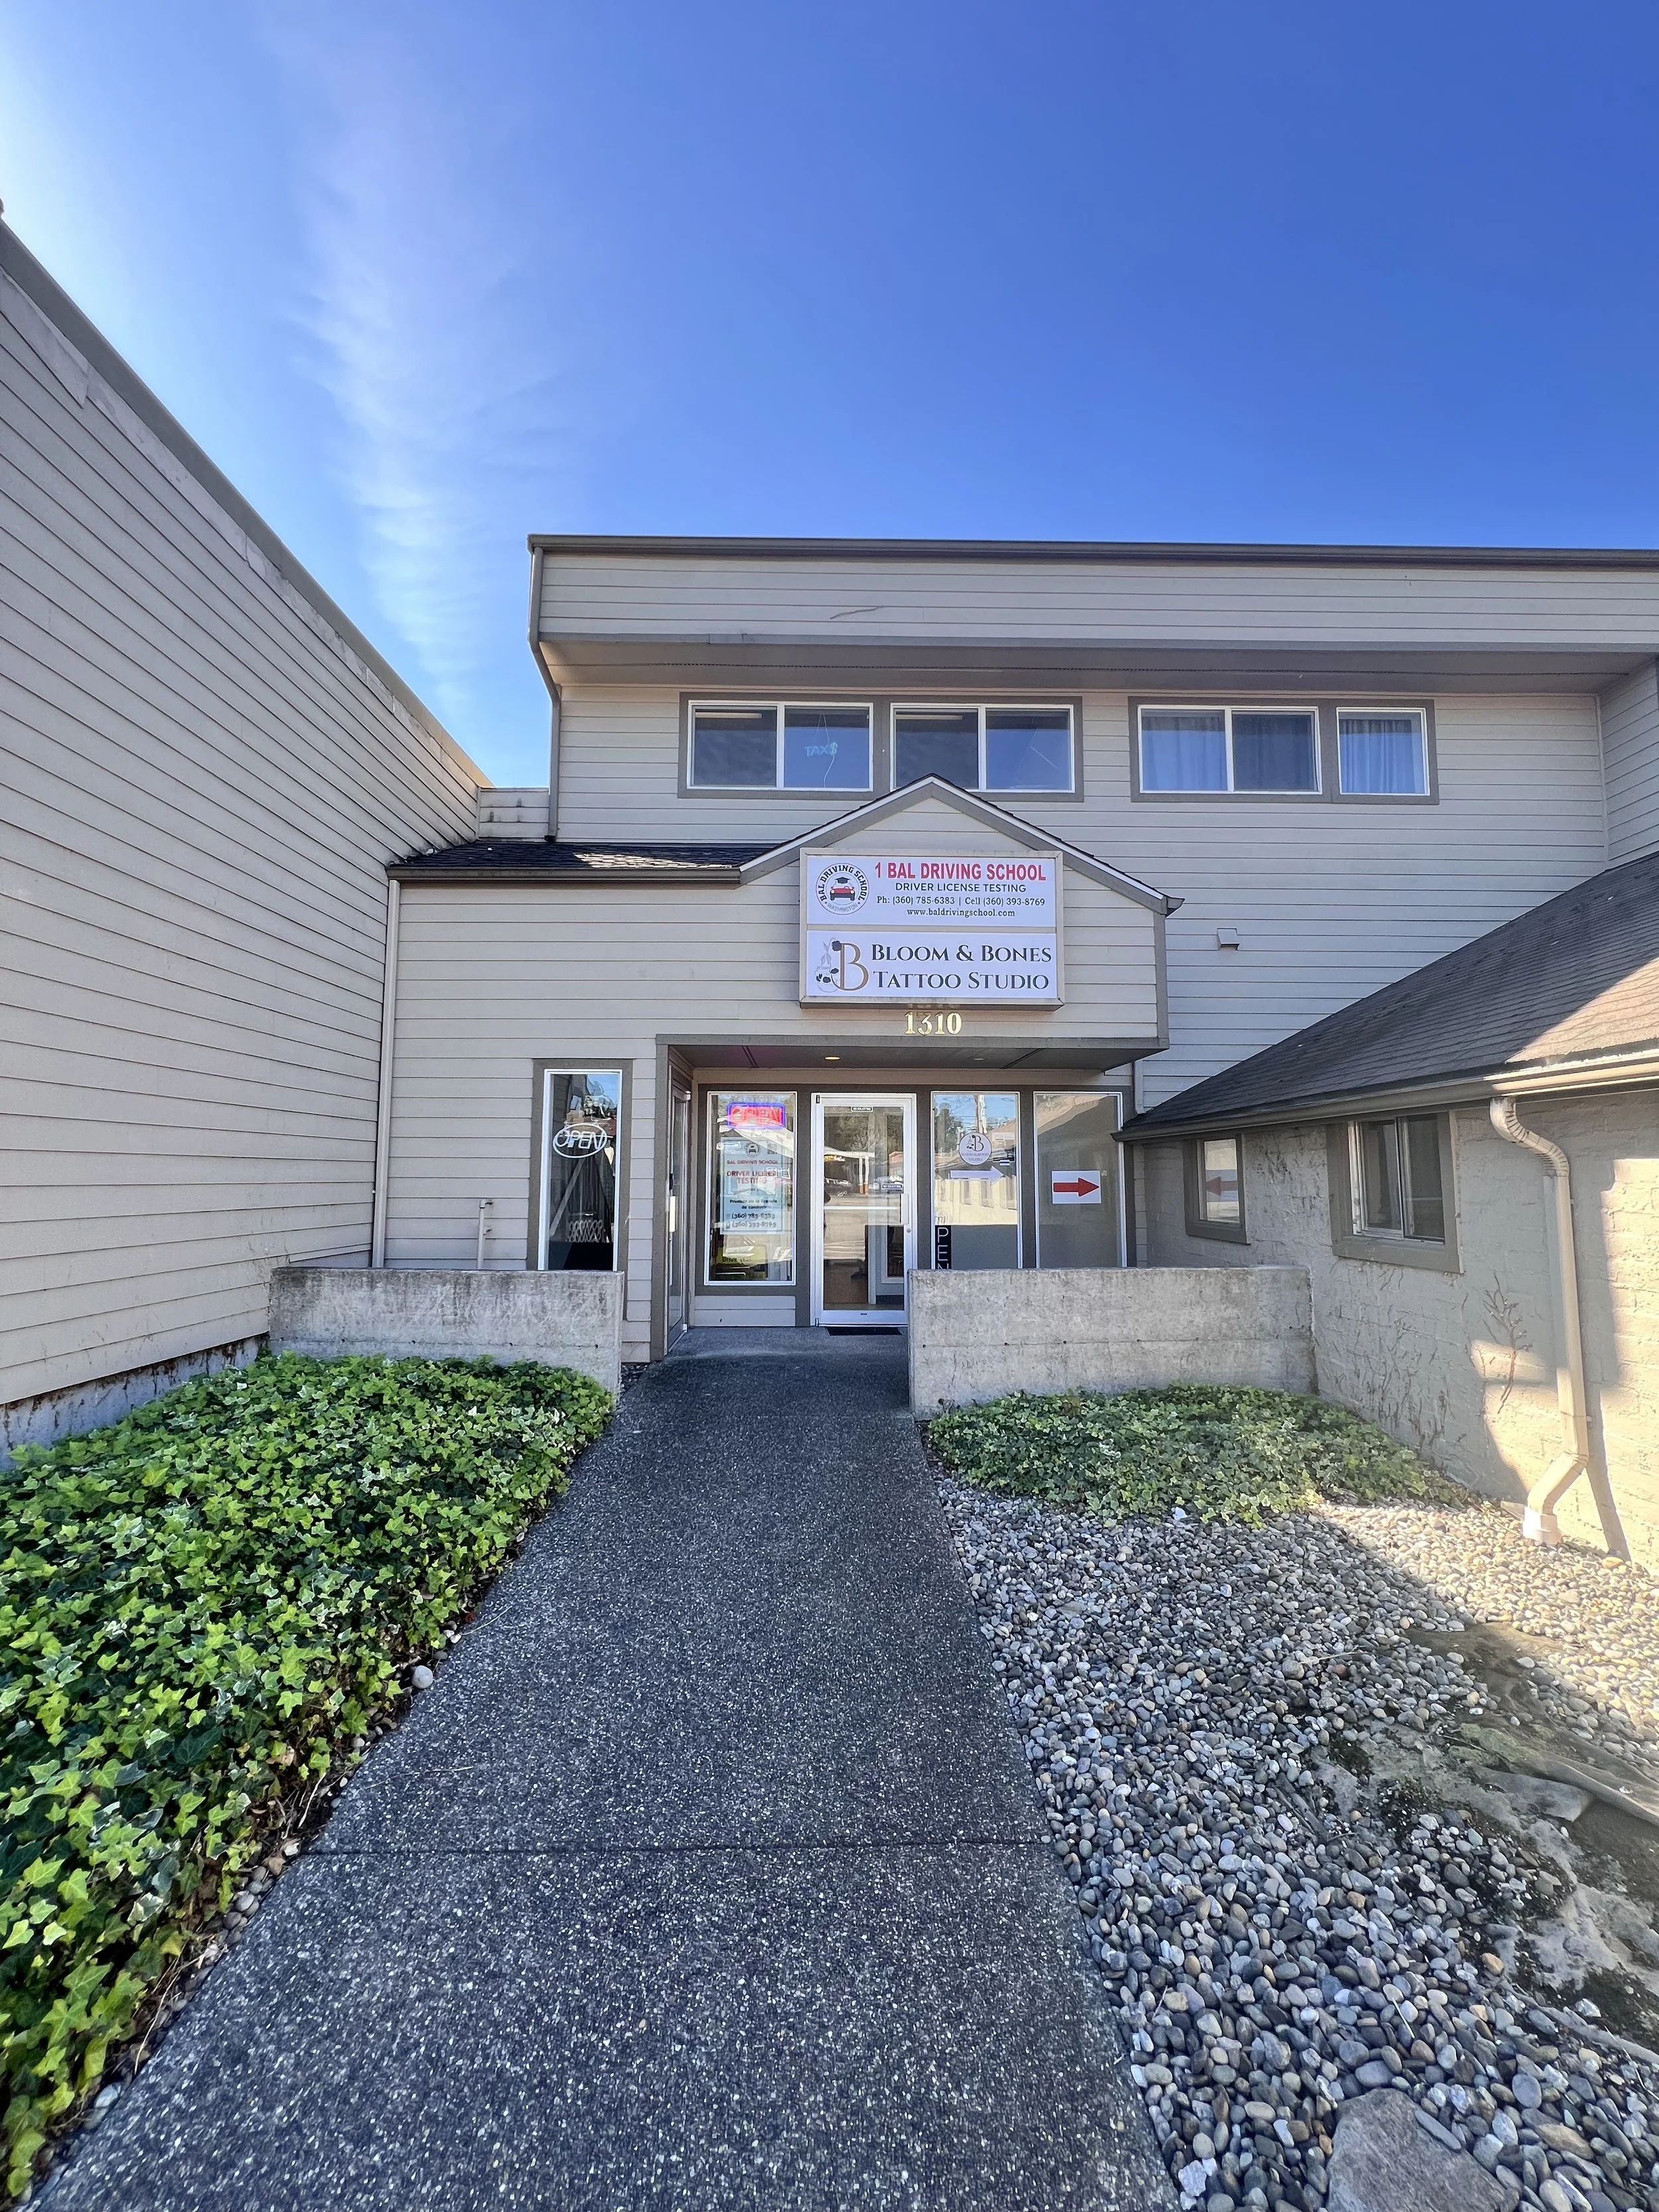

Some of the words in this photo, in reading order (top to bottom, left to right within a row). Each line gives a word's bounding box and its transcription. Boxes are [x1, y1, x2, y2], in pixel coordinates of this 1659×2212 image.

[820, 865, 854, 883] DRIVING
[875, 862, 881, 878] 1
[888, 862, 915, 879] BAL
[921, 863, 981, 880] DRIVING
[986, 863, 1046, 881] SCHOOL
[818, 884, 828, 901] BAL
[854, 871, 867, 901] SCHOOL
[895, 883, 934, 891] DRIVER
[937, 883, 980, 892] LICENSE
[983, 884, 1027, 893] TESTING
[827, 903, 859, 913] WASHINGTON
[877, 895, 890, 904] Ph:
[893, 896, 913, 906] (360)
[916, 896, 955, 905] 785-6383
[965, 897, 980, 905] Cell
[983, 897, 1003, 907] (360)
[906, 907, 1015, 918] www.baldrivingschool.com
[956, 944, 974, 962] &
[904, 1011, 962, 1035] 1310
[730, 1106, 782, 1127] OPEN
[555, 1129, 605, 1149] OPEN
